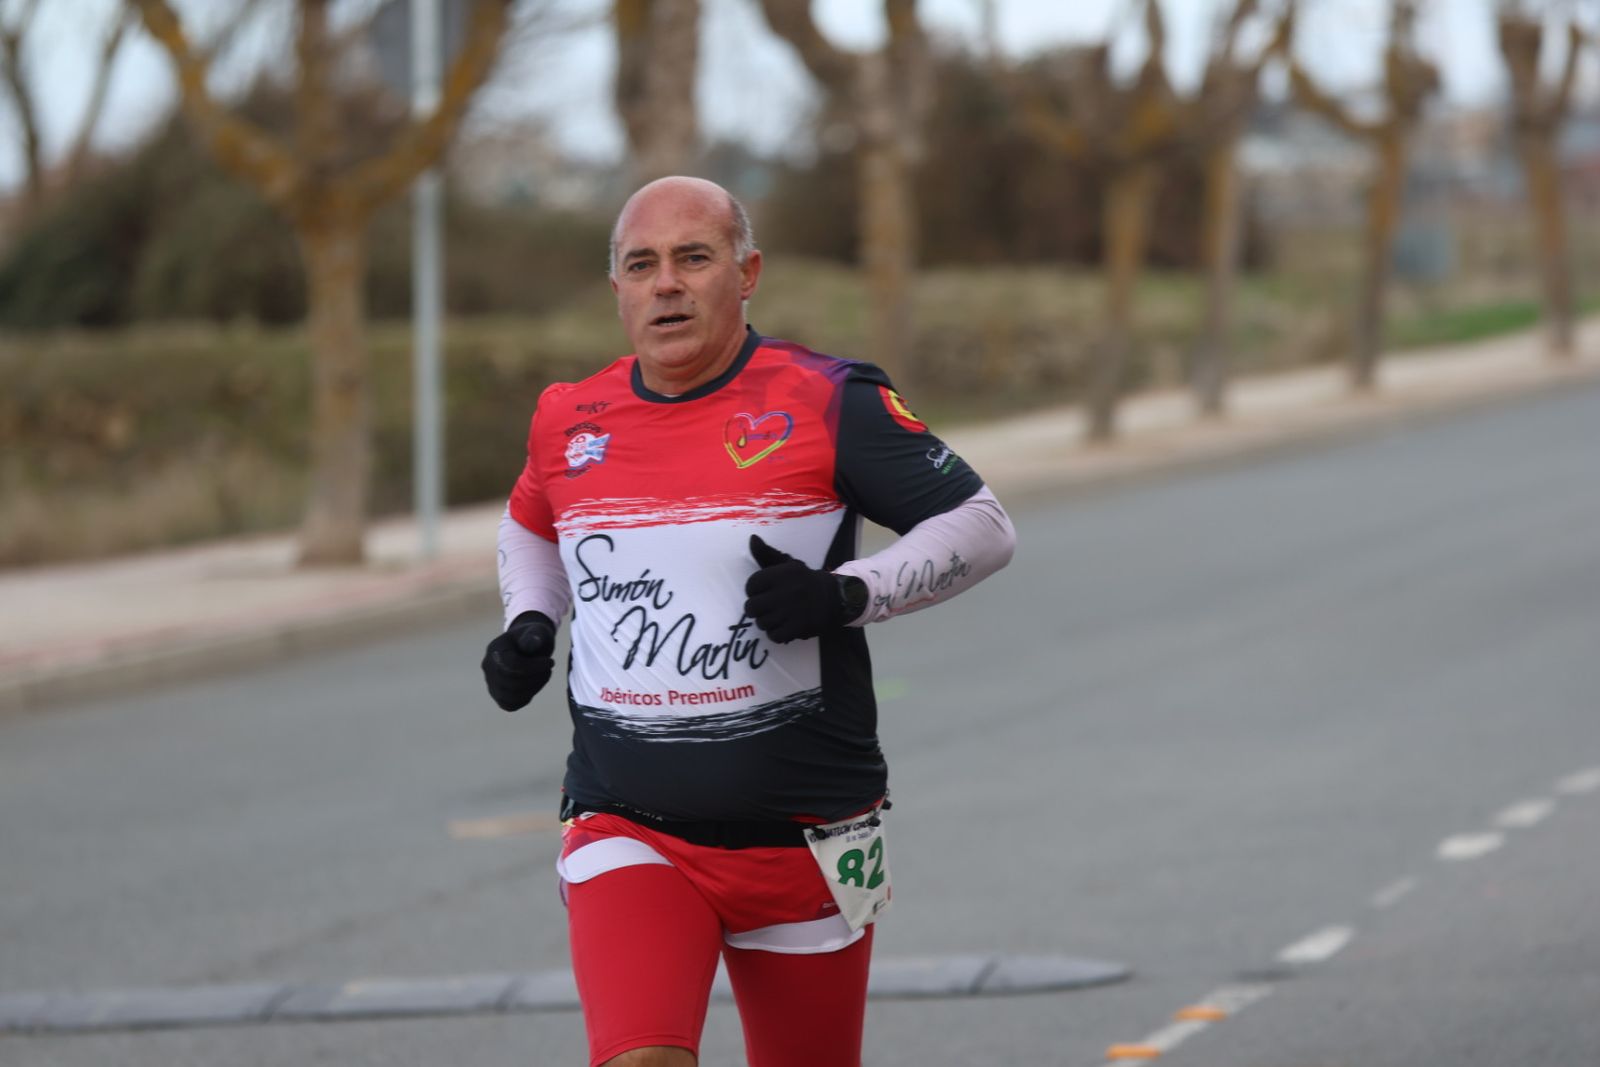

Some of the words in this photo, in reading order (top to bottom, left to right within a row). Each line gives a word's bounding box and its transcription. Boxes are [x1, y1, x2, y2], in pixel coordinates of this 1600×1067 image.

[575, 533, 674, 610] Simón
[610, 605, 769, 681] Martín
[667, 683, 756, 706] Premium
[837, 835, 885, 891] 82
